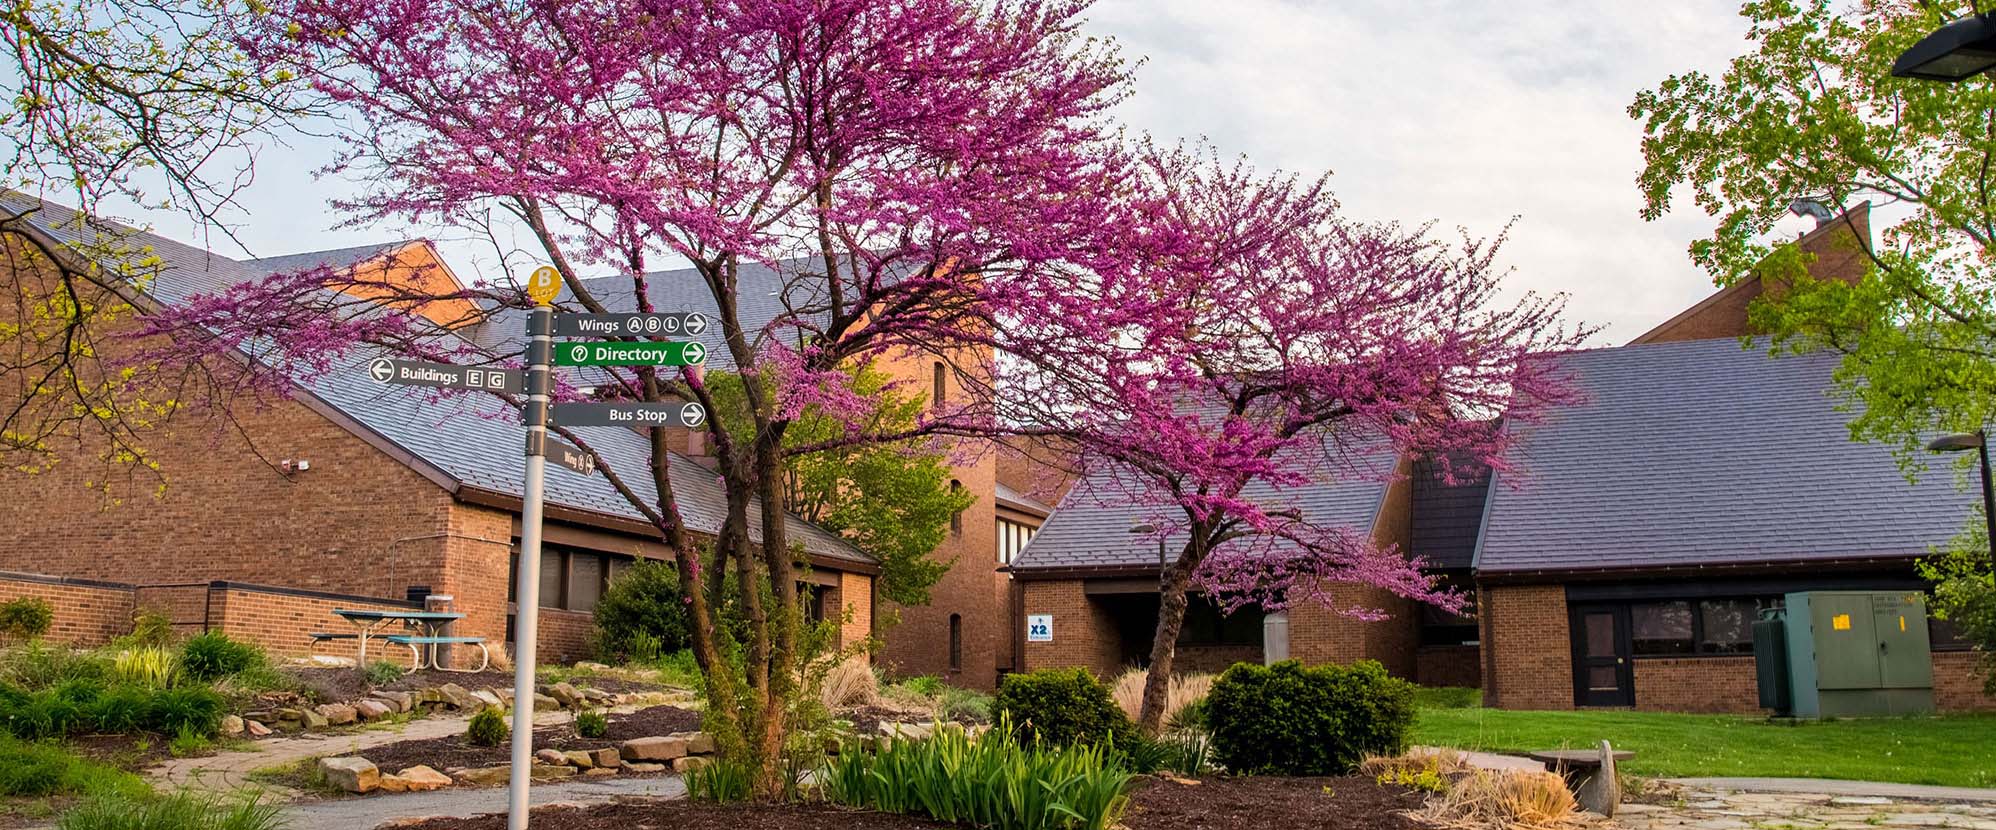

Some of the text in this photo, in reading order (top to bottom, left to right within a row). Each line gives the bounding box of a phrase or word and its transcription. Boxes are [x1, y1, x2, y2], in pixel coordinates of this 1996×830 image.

[538, 269, 551, 287] B
[578, 319, 619, 332] Wings
[595, 347, 667, 363] Directory
[401, 367, 458, 385] Buildings
[609, 409, 667, 422] Bus Stop
[564, 451, 577, 469] Wing
[1031, 624, 1047, 635] X2
